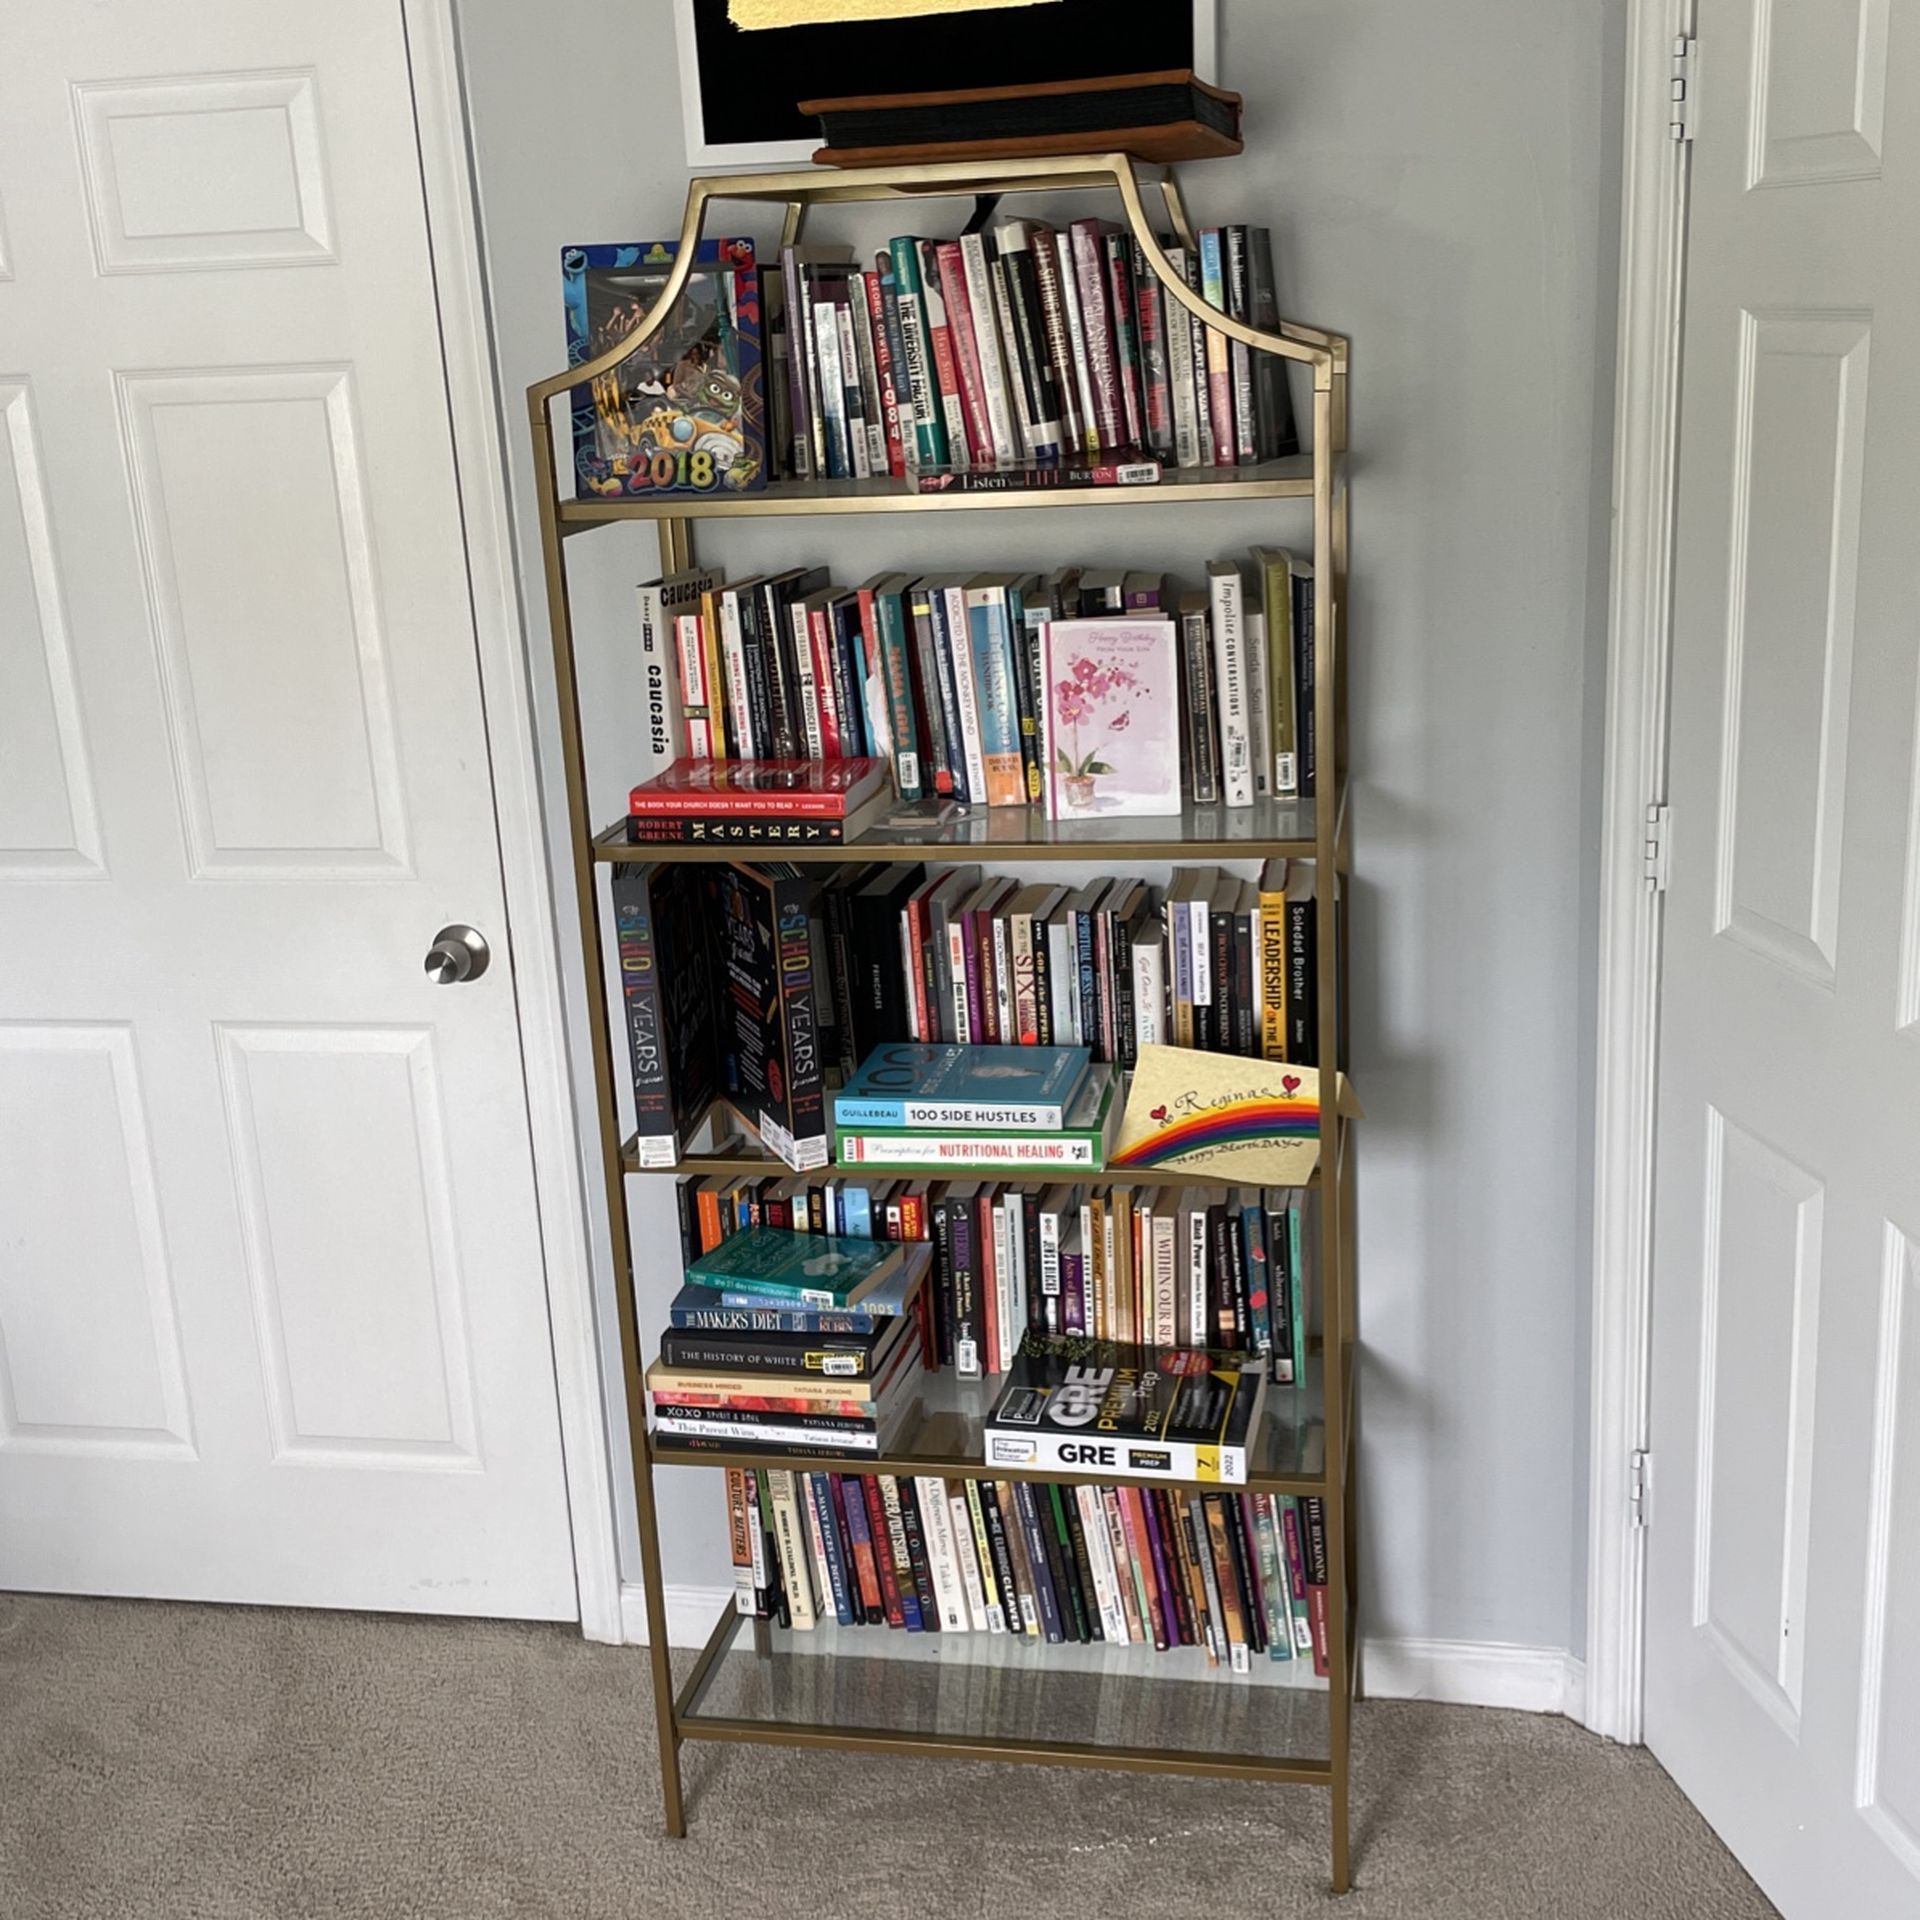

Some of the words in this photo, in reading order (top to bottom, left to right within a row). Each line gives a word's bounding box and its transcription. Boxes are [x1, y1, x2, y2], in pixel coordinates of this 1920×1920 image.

[1231, 232, 1242, 262] Black
[871, 279, 882, 320] GEORGE
[1039, 268, 1062, 310] SITTING
[1087, 273, 1104, 316] RACIAL
[899, 300, 914, 321] THE
[876, 325, 889, 365] ORWELL
[902, 323, 920, 376] DIVERSITY
[936, 332, 947, 358] Hair
[1046, 310, 1069, 368] TOGETHER
[1193, 342, 1204, 367] ART
[939, 362, 952, 391] Story
[1195, 368, 1205, 387] OF
[882, 372, 900, 440] 1984
[910, 379, 929, 419] FACTOR
[1196, 389, 1208, 421] WAR
[628, 451, 714, 488] 2018
[963, 474, 1007, 490] Listen
[1069, 469, 1112, 481] BURTON
[660, 575, 713, 607] caucasia
[950, 594, 962, 635] ADDICTED
[1219, 583, 1240, 634] Impolite
[955, 639, 964, 650] TO
[1088, 631, 1118, 645] Happy
[1119, 631, 1156, 645] Birthday
[958, 654, 967, 668] THE
[1248, 638, 1261, 673] Seeds
[753, 648, 762, 681] SANCTIONS
[758, 697, 768, 732] SANCTUARY
[960, 670, 972, 709] MONKEY
[1226, 638, 1240, 717] CONVERSATIONS
[648, 665, 669, 754] caucasia
[805, 690, 817, 731] PRODUCED
[820, 685, 834, 714] PIMP
[1251, 688, 1262, 715] Soul
[967, 712, 975, 735] MIND
[809, 734, 818, 746] BY
[635, 801, 648, 810] THE
[666, 801, 682, 810] YOUR
[683, 801, 708, 810] CHURCH
[753, 801, 767, 810] YOU
[767, 801, 776, 810] TO
[776, 801, 793, 810] READ
[638, 820, 683, 830] ROBERT
[638, 830, 684, 840] GREENE
[692, 821, 820, 841] MASTERY
[1078, 914, 1093, 964] SPIRITUAL
[1292, 907, 1304, 953] Soledad
[619, 916, 652, 997] SCHOOL
[779, 914, 813, 998] SCHOOL
[1036, 951, 1044, 973] GOD
[1263, 921, 1282, 1010] LEADERSHIP
[872, 963, 882, 1010] PRINCIPLES
[1015, 955, 1035, 996] SIX
[1038, 976, 1044, 985] of
[1081, 966, 1095, 995] CHESS
[1293, 958, 1304, 1001] Brother
[1266, 1011, 1277, 1024] ON
[632, 997, 658, 1073] YEARS
[789, 996, 814, 1074] YEARS
[1267, 1027, 1277, 1042] THE
[1266, 1045, 1283, 1062] LI
[842, 1109, 898, 1119] GUILLEBEAU
[910, 1110, 938, 1121] 100
[940, 1110, 972, 1121] SIDE
[975, 1111, 1037, 1123] HUSTLES
[939, 1144, 1014, 1158] NUTRITIONAL
[1017, 1144, 1064, 1158] HEALING
[935, 1210, 948, 1245] OCTAVIA
[1194, 1219, 1202, 1240] Black
[1217, 1223, 1226, 1245] Victory
[953, 1222, 970, 1270] INTERIORS
[1043, 1241, 1055, 1259] JEWS
[1194, 1244, 1206, 1269] Power
[940, 1257, 951, 1288] BUTLER
[1066, 1262, 1076, 1277] Acts
[1158, 1239, 1172, 1285] WITHIN
[1219, 1254, 1228, 1280] Spiritual
[1044, 1266, 1057, 1292] BLACKS
[1067, 1281, 1075, 1290] of
[1234, 1278, 1242, 1293] People
[1275, 1265, 1284, 1306] whiteness
[1158, 1289, 1172, 1320] OUR
[1221, 1281, 1229, 1305] Warfare
[697, 1311, 749, 1329] MAKER'S
[751, 1311, 783, 1330] DIET
[862, 1302, 895, 1315] SOUL
[819, 1320, 853, 1332] RUBIN
[1159, 1324, 1172, 1347] REA
[681, 1351, 700, 1360] THE
[703, 1352, 745, 1363] HISTORY
[747, 1354, 761, 1364] OF
[764, 1355, 797, 1366] WHITE
[677, 1381, 714, 1389] BUSINESS
[794, 1386, 823, 1394] TATIANA
[824, 1387, 852, 1395] JEROME
[1050, 1365, 1115, 1427] GRE
[1132, 1371, 1161, 1399] Prep
[1098, 1368, 1140, 1430] PREMIUM
[667, 1406, 702, 1419] XOXO
[706, 1410, 731, 1420] SPIRIT
[803, 1418, 835, 1428] TATIANA
[836, 1421, 866, 1430] JEROME
[1143, 1411, 1161, 1432] 2022
[677, 1422, 697, 1433] This
[699, 1424, 729, 1436] Parent
[1058, 1443, 1116, 1466] GRE
[1131, 1451, 1168, 1460] PREMIUM
[1139, 1458, 1161, 1467] PREP
[1197, 1457, 1212, 1469] 7
[1224, 1454, 1234, 1476] 2022
[730, 1471, 744, 1512] CULTURE
[815, 1483, 823, 1496] THE
[928, 1479, 938, 1487] A
[818, 1496, 828, 1522] MANY
[903, 1509, 918, 1531] THE
[929, 1488, 945, 1527] Different
[1308, 1498, 1320, 1522] THE
[780, 1510, 788, 1537] ROBERT
[879, 1475, 910, 1570] INSIDER/OUTSIDER
[1111, 1513, 1122, 1529] Young
[734, 1516, 746, 1557] MATTERS
[823, 1524, 834, 1552] FACES
[1261, 1544, 1273, 1576] Brain
[1313, 1525, 1325, 1582] RECKONING
[830, 1565, 843, 1599] DECEIT
[994, 1537, 1010, 1576] ELDRIDGE
[1002, 1576, 1021, 1631] CLEAVER
